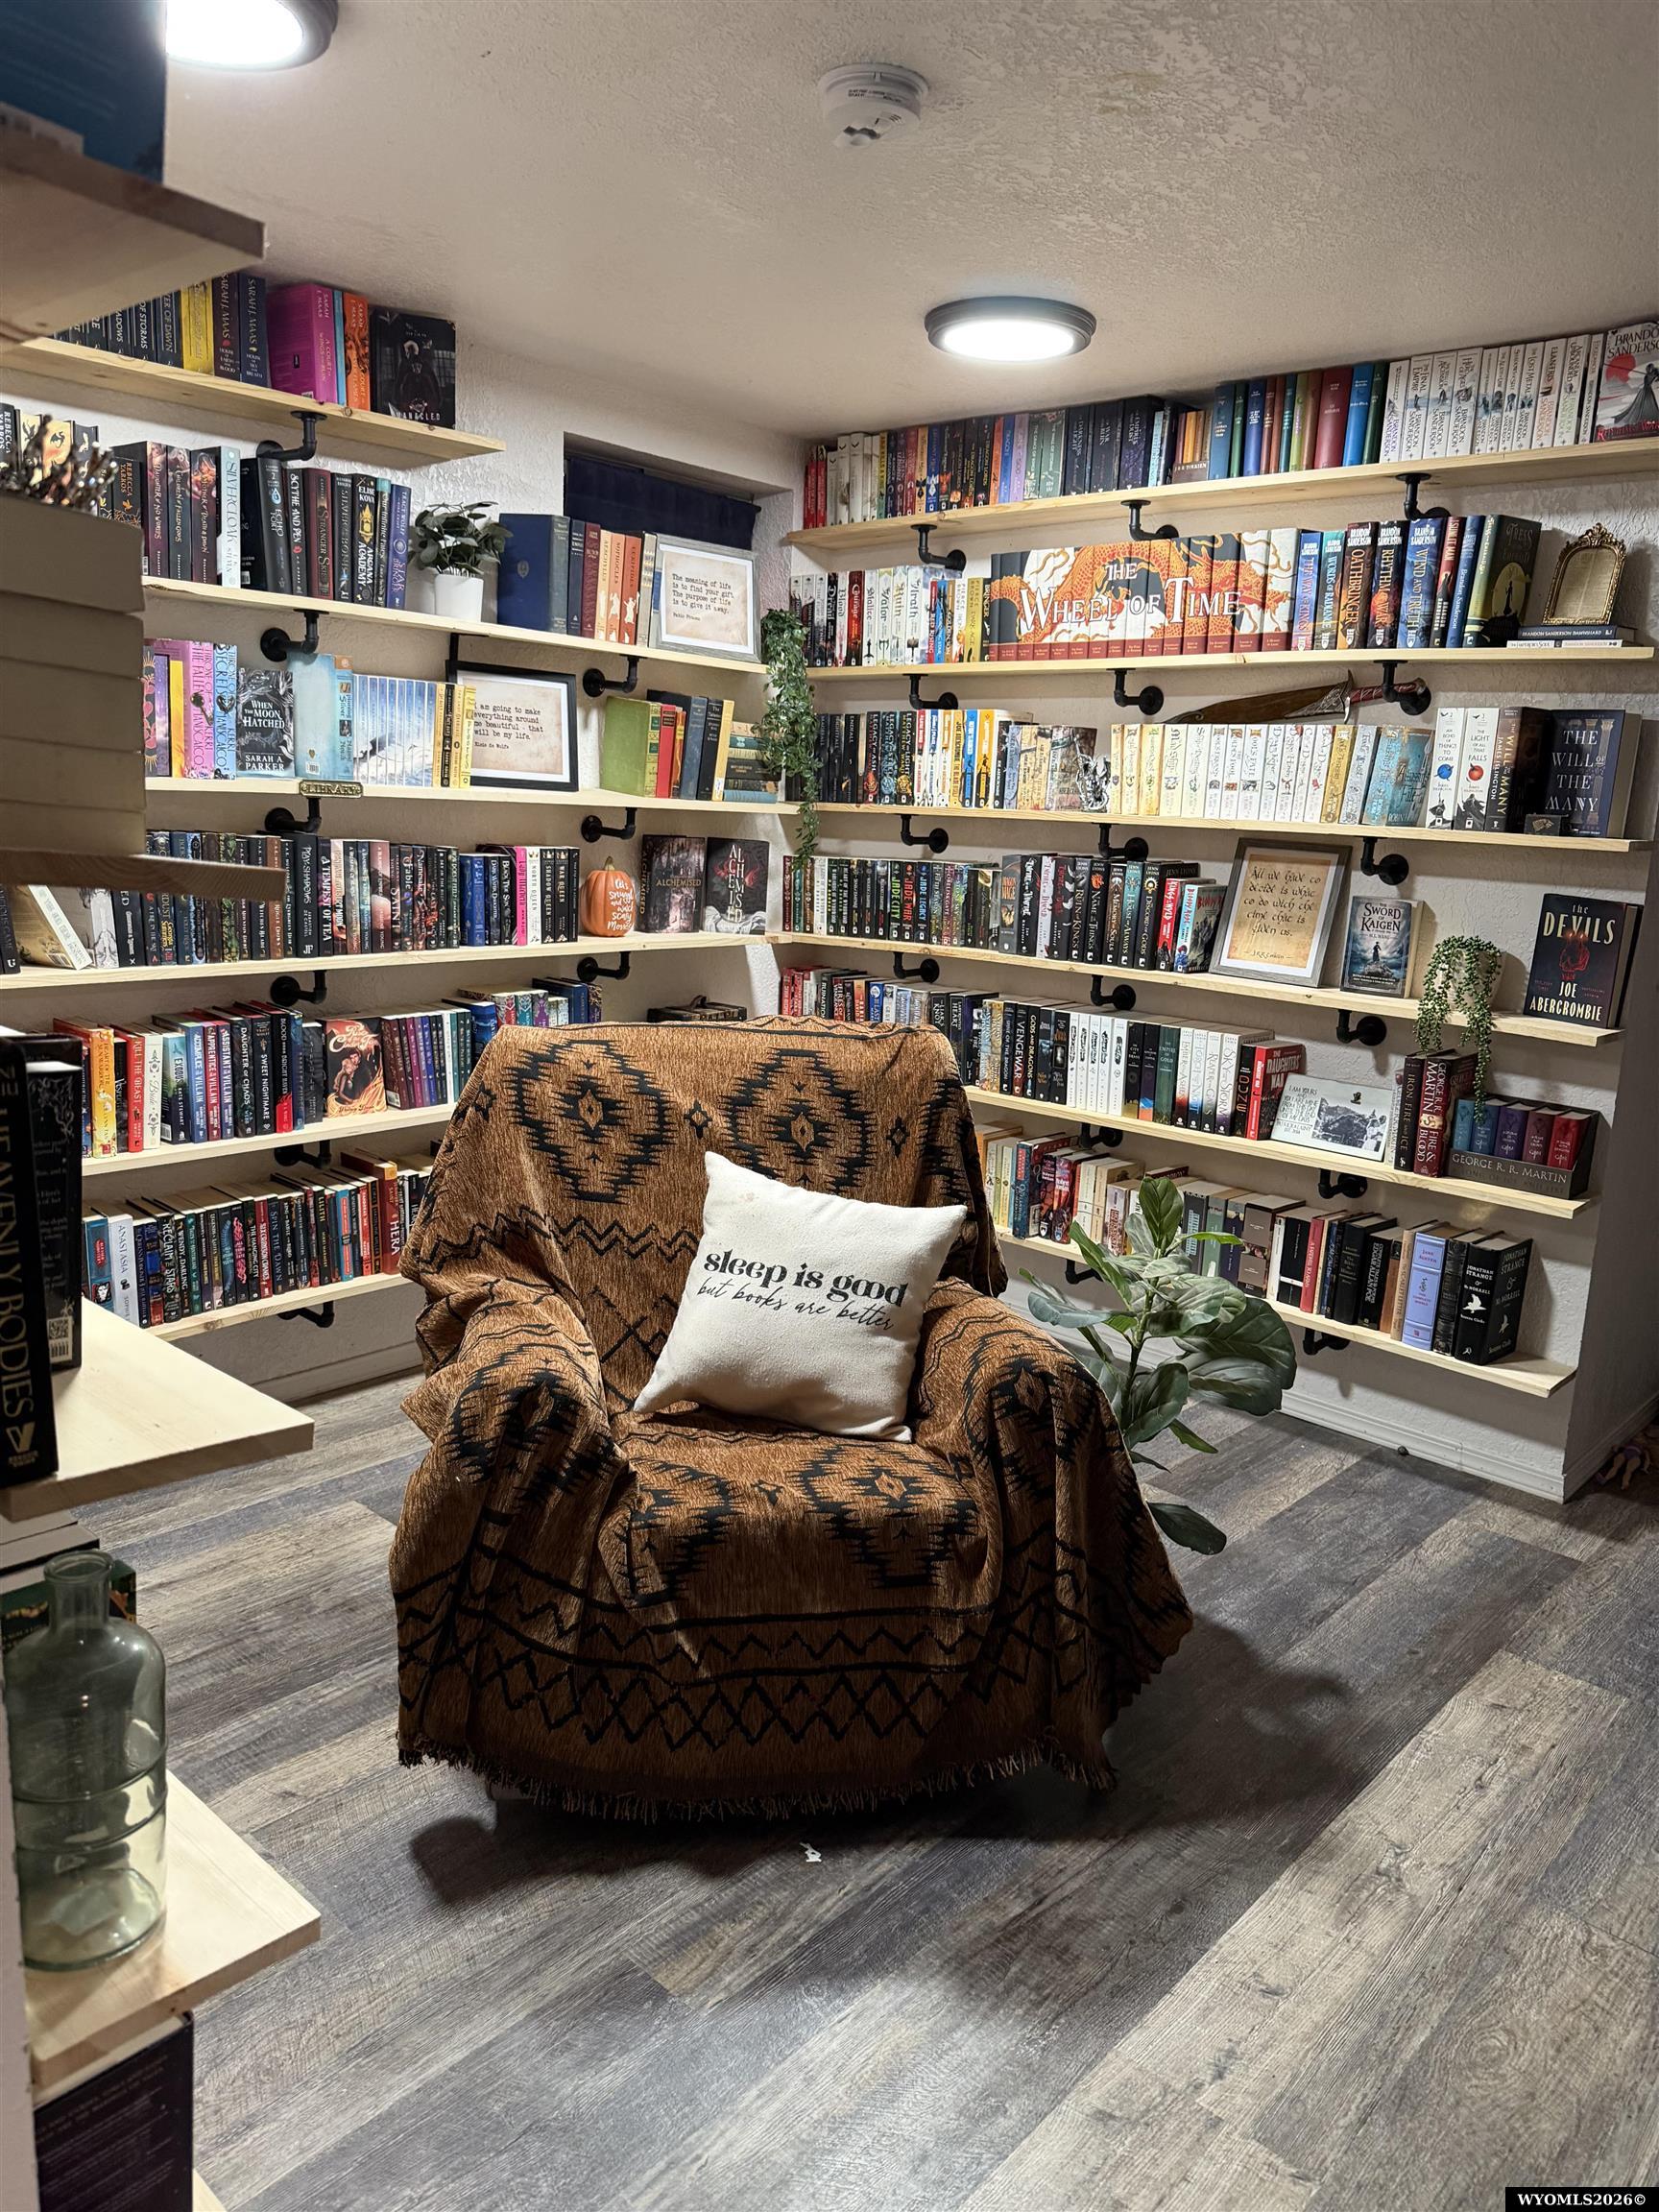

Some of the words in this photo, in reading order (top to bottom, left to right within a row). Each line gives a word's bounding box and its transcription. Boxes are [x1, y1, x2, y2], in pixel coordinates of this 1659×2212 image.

[1547, 346, 1559, 385] ELANTRIS
[1383, 416, 1394, 457] SANDERSON
[1406, 410, 1416, 452] SANDERSON
[1412, 414, 1422, 447] BRANDON
[1429, 408, 1440, 450] SANDERSON
[1451, 405, 1462, 448] SANDERSON
[1458, 408, 1469, 444] BRANDON
[359, 493, 375, 504] KOVA
[275, 508, 283, 537] ECHO
[1346, 536, 1372, 547] SANDERSON
[357, 541, 367, 588] ACADEMY
[1105, 562, 1139, 582] THE
[1326, 556, 1337, 584] WORDS
[1379, 548, 1395, 592] RHYTHM
[1412, 547, 1429, 578] WIND
[685, 576, 709, 587] meaning
[1344, 549, 1366, 625] OATHBRINGER
[1459, 568, 1468, 593] Brandon
[685, 592, 709, 602] purpose
[982, 584, 991, 617] BRINGER
[1019, 586, 1118, 636] WHEEL
[1130, 593, 1162, 616] OF
[1164, 575, 1243, 625] TIME
[1322, 591, 1334, 630] RADIANCE
[1298, 604, 1310, 631] KINGS
[1374, 602, 1389, 630] WAR
[1406, 593, 1423, 630] TRUTH
[1451, 592, 1462, 630] Sanderson
[251, 700, 274, 709] WHEN
[252, 709, 283, 720] MOON
[474, 711, 513, 722] everything
[516, 714, 540, 724] around
[493, 705, 512, 713] going
[242, 716, 285, 730] HATCHED
[486, 721, 519, 731] beautiful
[1494, 736, 1504, 758] JAMES
[1503, 735, 1515, 766] WILL
[1563, 730, 1599, 745] THE
[245, 761, 285, 772] PARKER
[1551, 752, 1597, 768] WILL
[1489, 758, 1502, 801] ISLINGTON
[1556, 774, 1592, 790] THE
[1497, 775, 1511, 815] MANY
[1545, 795, 1599, 813] MANY
[402, 856, 414, 890] Fable
[655, 878, 702, 888] ALCHEMISED
[919, 876, 927, 896] JADE
[322, 866, 332, 908] TEMPEST
[891, 877, 901, 900] JADE
[904, 878, 913, 902] JADE
[390, 887, 401, 929] SAINT
[890, 901, 901, 920] CITY
[902, 902, 912, 922] WAR
[918, 896, 927, 922] LEGACY
[1074, 889, 1085, 914] RUIN
[1125, 894, 1136, 920] HOUSE
[1363, 902, 1402, 920] SWORD
[1572, 903, 1589, 915] the
[323, 923, 332, 941] TEA
[1071, 920, 1082, 949] KINGS
[1088, 921, 1099, 950] THINGS
[1360, 916, 1402, 932] KAIGEN
[1542, 911, 1616, 946] DEVILS
[1108, 928, 1118, 951] SOULS
[1122, 925, 1133, 954] ALWAYS
[1140, 932, 1149, 955] GODS
[1558, 981, 1578, 999] JOE
[933, 1002, 943, 1026] KNOT
[1529, 997, 1603, 1022] ABERCROMBIE
[1028, 1015, 1037, 1033] GODS
[222, 1029, 230, 1070] ASSISTANT
[240, 1027, 250, 1068] DAUGHTER
[1014, 1021, 1025, 1078] VENGEWAR
[1219, 1049, 1237, 1073] SKY
[174, 1057, 184, 1084] EXODUS
[260, 1054, 269, 1076] SWEET
[1027, 1046, 1036, 1079] DRAGONS
[133, 1078, 142, 1105] BEAST
[195, 1074, 204, 1103] VILLAIN
[208, 1076, 217, 1104] VILLAIN
[222, 1074, 231, 1103] VILLAIN
[242, 1078, 251, 1105] CHAOS
[1421, 1061, 1438, 1113] MARTIN
[1437, 1062, 1448, 1096] GEORGE
[261, 1078, 271, 1120] NIGHTMARE
[1217, 1082, 1233, 1118] STORM
[1404, 1103, 1412, 1123] FIRE
[1399, 1135, 1409, 1151] ICE
[1416, 1129, 1429, 1162] BLOOD
[1428, 1130, 1439, 1149] FIRE
[1451, 1152, 1493, 1170] GEORGE
[1496, 1162, 1506, 1172] R.
[1508, 1165, 1520, 1174] R.
[1522, 1167, 1568, 1184] MARTIN
[117, 1225, 129, 1274] ANASTASIA
[162, 1223, 174, 1263] RECLAIM
[389, 1220, 401, 1256] HERA
[1369, 1242, 1381, 1264] EDGAR
[1419, 1255, 1437, 1263] AUSTEN
[1501, 1257, 1527, 1275] STRANGE
[165, 1268, 176, 1294] STARS
[704, 1248, 788, 1289] sleep
[792, 1262, 825, 1289] is
[826, 1274, 909, 1309] good
[1367, 1265, 1377, 1287] ALLAN
[1465, 1269, 1493, 1281] STRANGE
[1466, 1264, 1495, 1276] JONATHAN
[697, 1276, 733, 1298] but
[731, 1282, 788, 1311] books
[794, 1300, 831, 1315] are
[836, 1299, 895, 1331] better
[1469, 1286, 1491, 1295] NORRELL
[0, 1300, 35, 1418] BODIES
